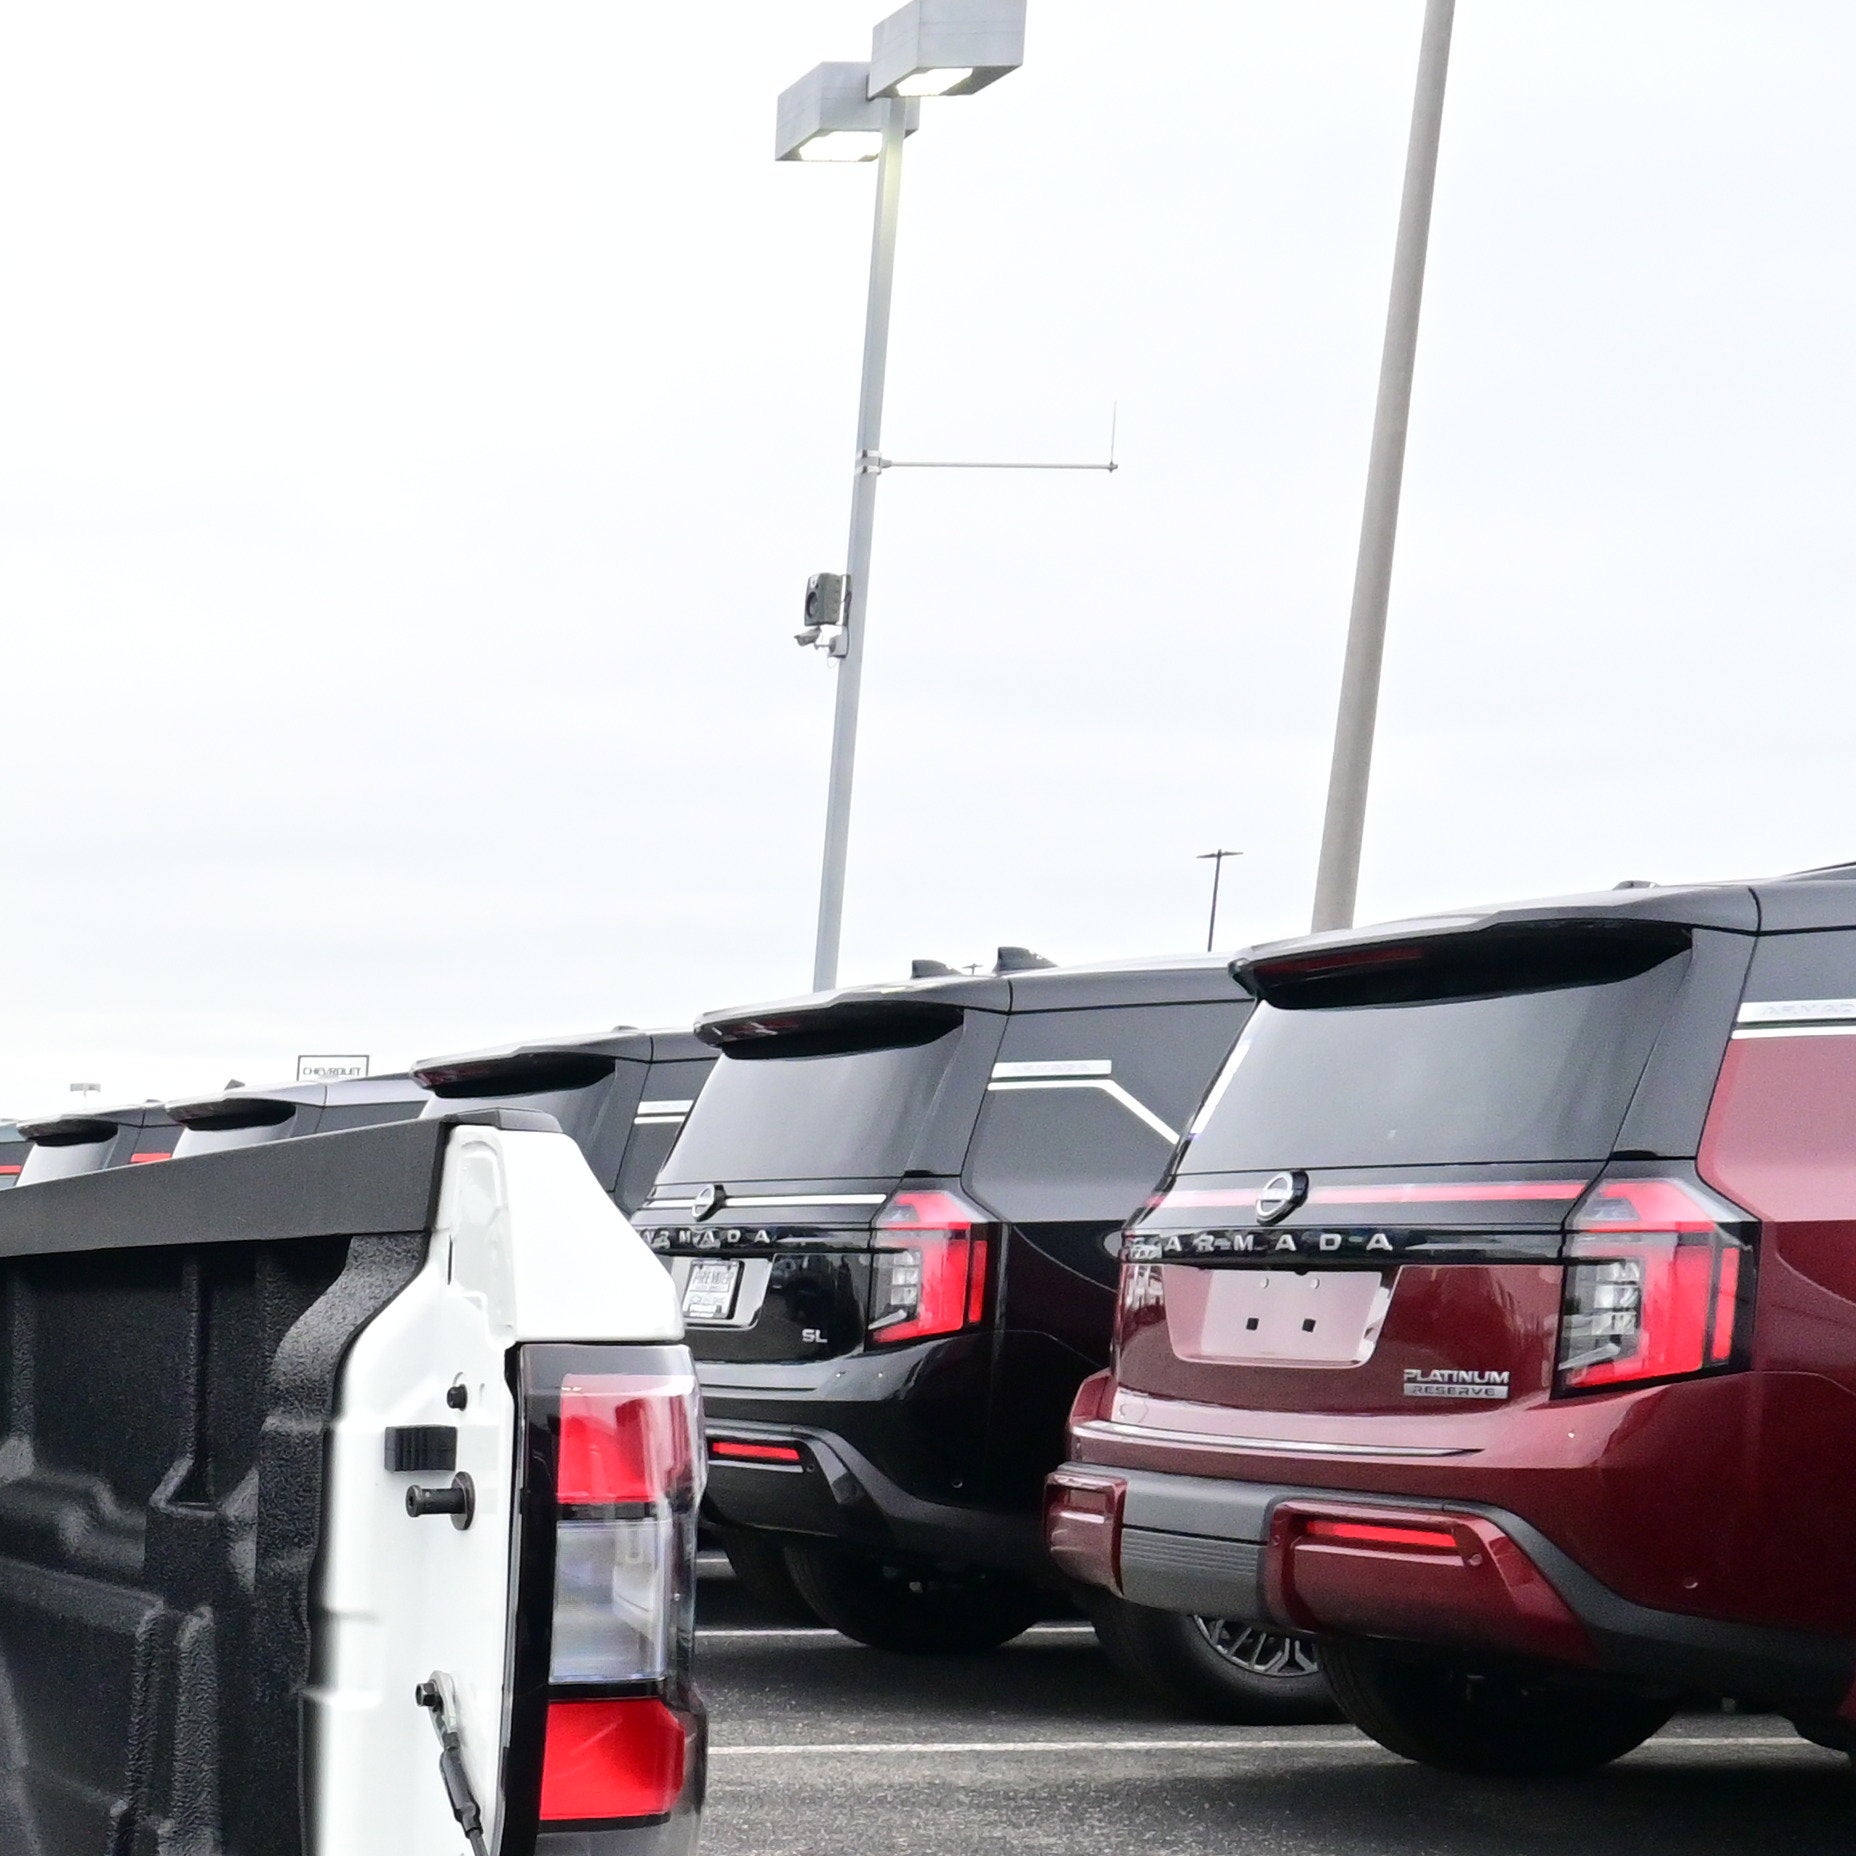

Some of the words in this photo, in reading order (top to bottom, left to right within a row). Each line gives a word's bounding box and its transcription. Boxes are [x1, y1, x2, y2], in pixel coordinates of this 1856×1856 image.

[1164, 1233, 1394, 1252] ARMADA
[801, 1328, 828, 1343] SL
[1403, 1369, 1510, 1383] PLATINUM
[1412, 1385, 1496, 1397] RESERVE
